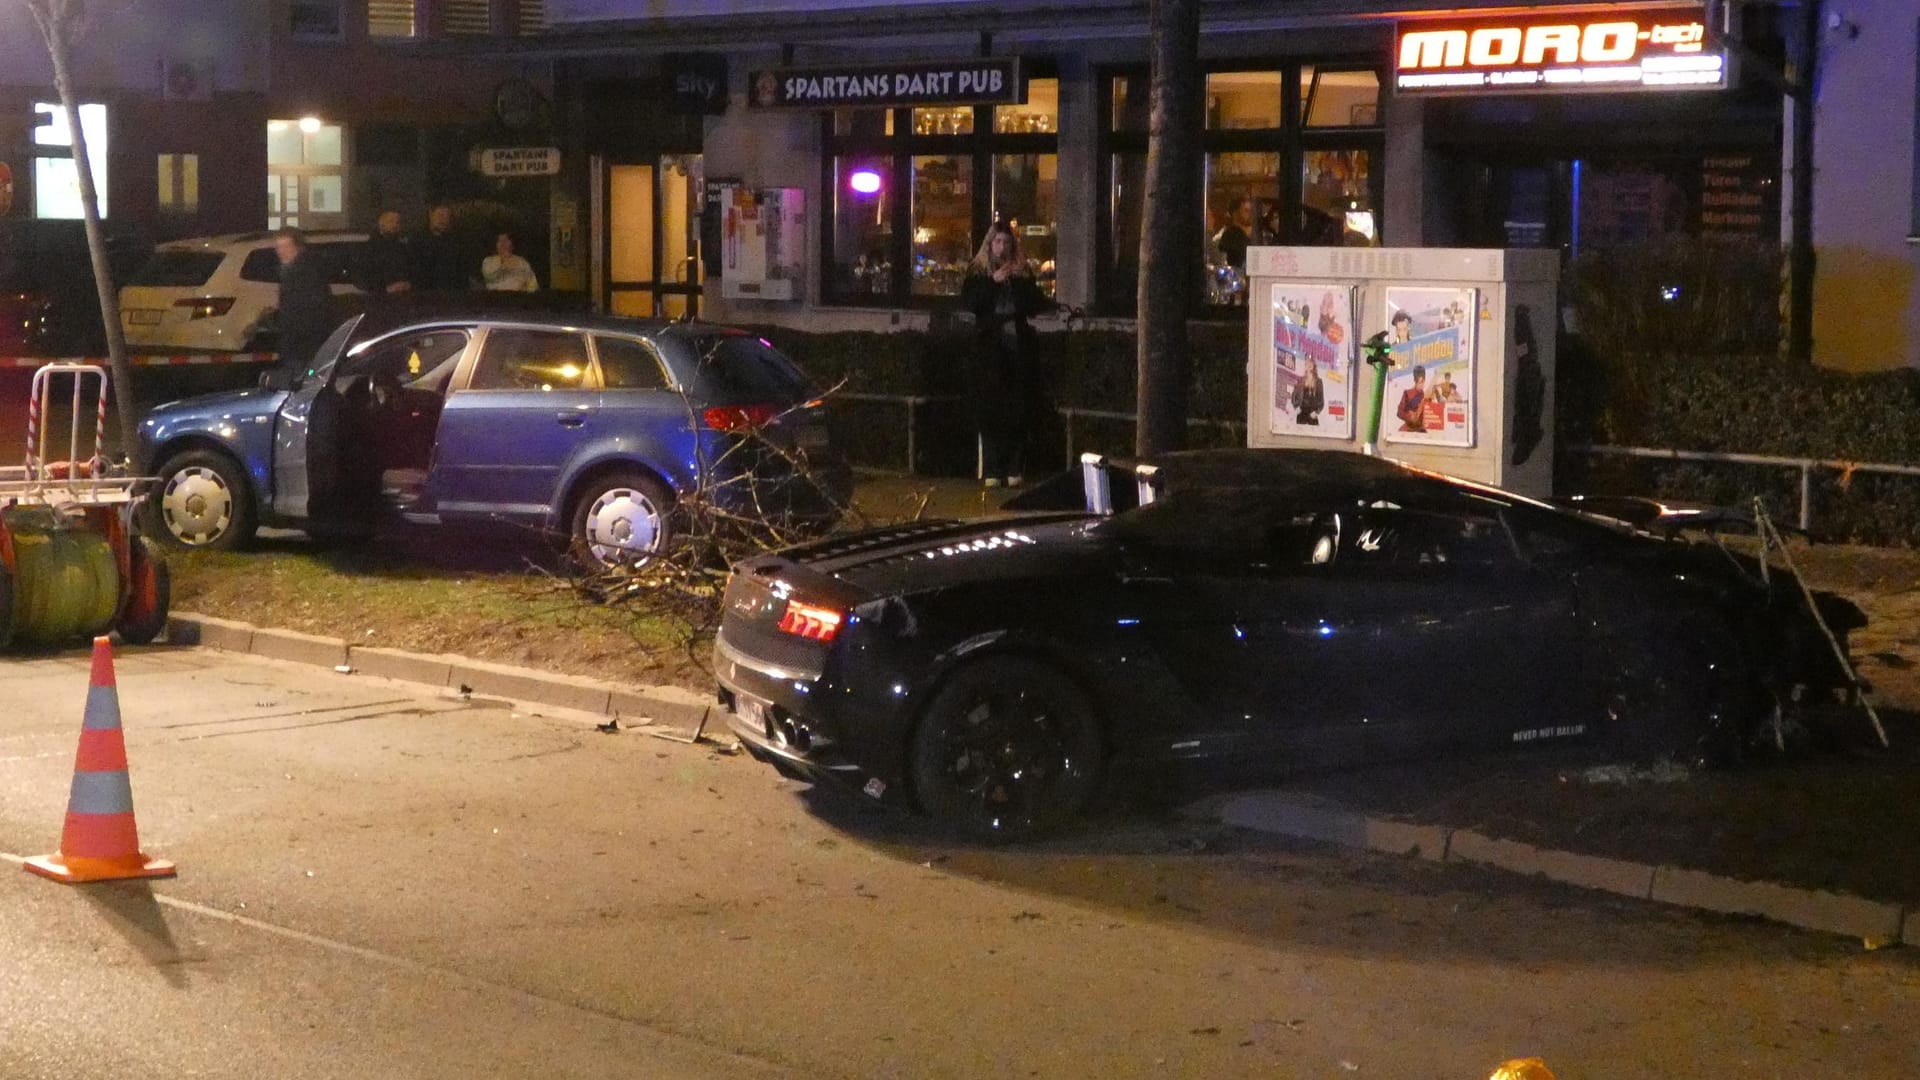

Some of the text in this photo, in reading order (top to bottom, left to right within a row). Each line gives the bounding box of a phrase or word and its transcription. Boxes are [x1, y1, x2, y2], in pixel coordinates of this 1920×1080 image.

[785, 69, 1003, 100] SPARTANS DART PUB
